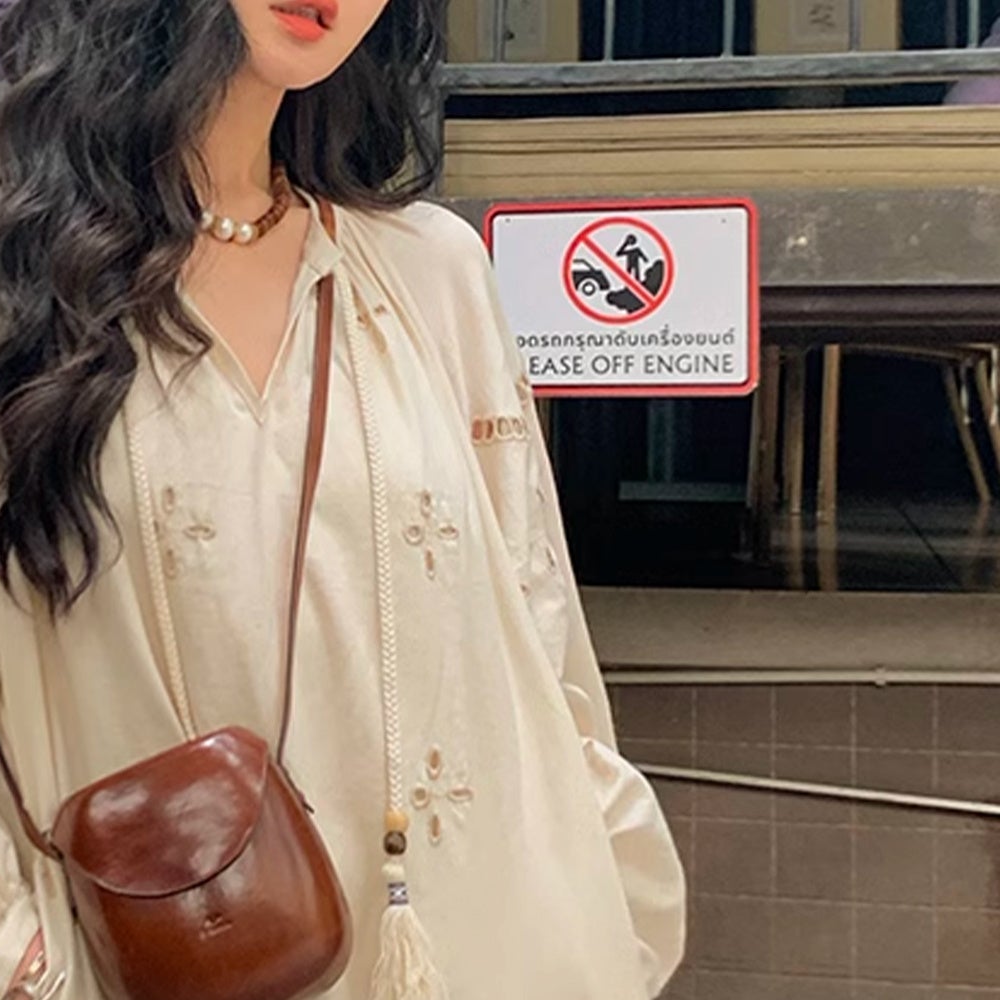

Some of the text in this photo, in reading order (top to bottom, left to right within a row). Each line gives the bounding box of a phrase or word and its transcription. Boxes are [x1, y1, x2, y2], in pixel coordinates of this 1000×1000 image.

[529, 353, 734, 375] EASE OFF ENGINE
